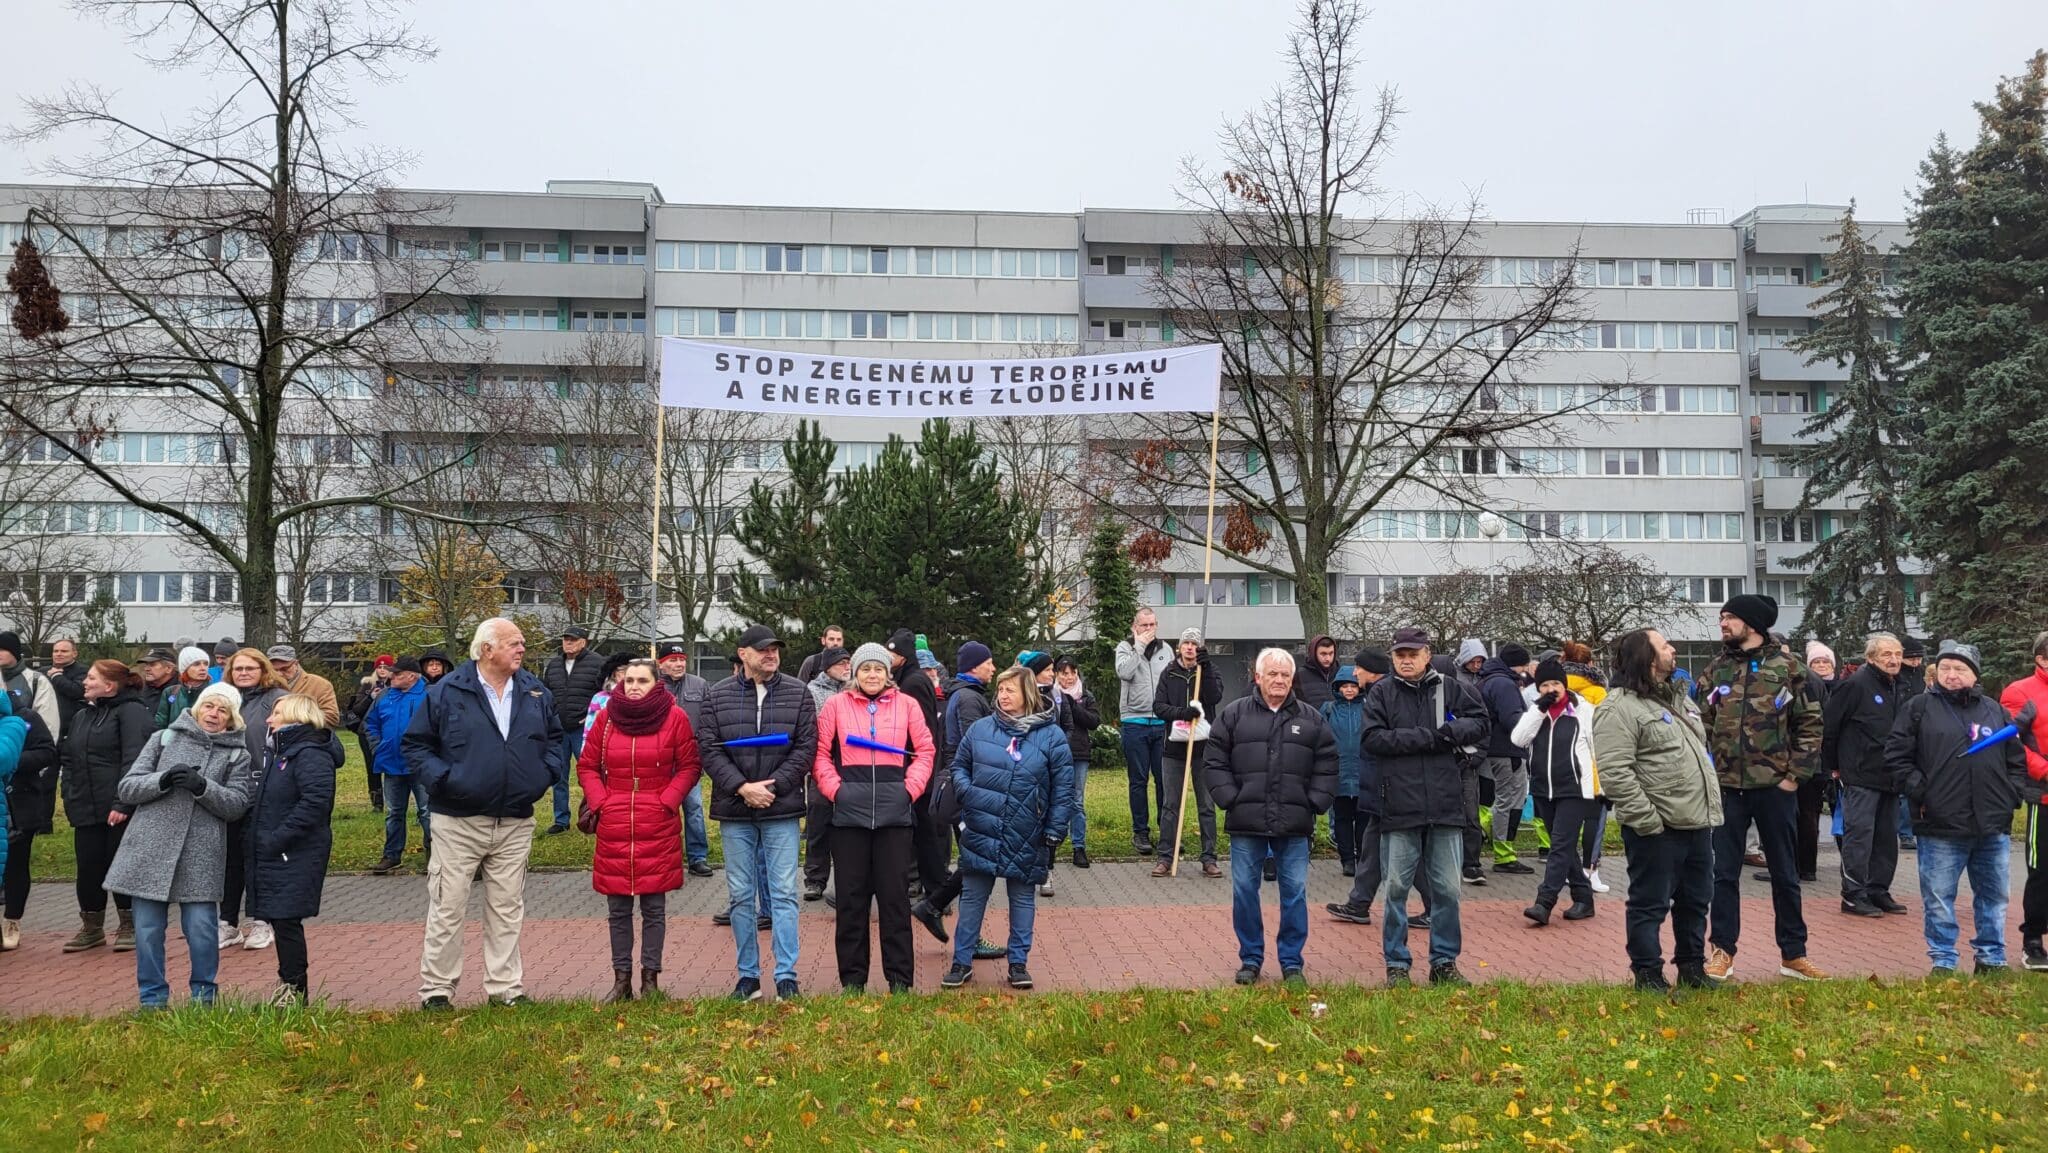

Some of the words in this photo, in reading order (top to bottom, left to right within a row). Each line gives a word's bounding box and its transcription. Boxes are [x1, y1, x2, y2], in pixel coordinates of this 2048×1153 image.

[715, 352, 794, 377] STOP
[810, 360, 974, 385] ZELENÉMU
[990, 357, 1168, 384] TERORISMU
[726, 380, 744, 400] A
[761, 382, 974, 406] ENERGETICKÉ
[990, 377, 1155, 405] ZLODĚJINĚ
